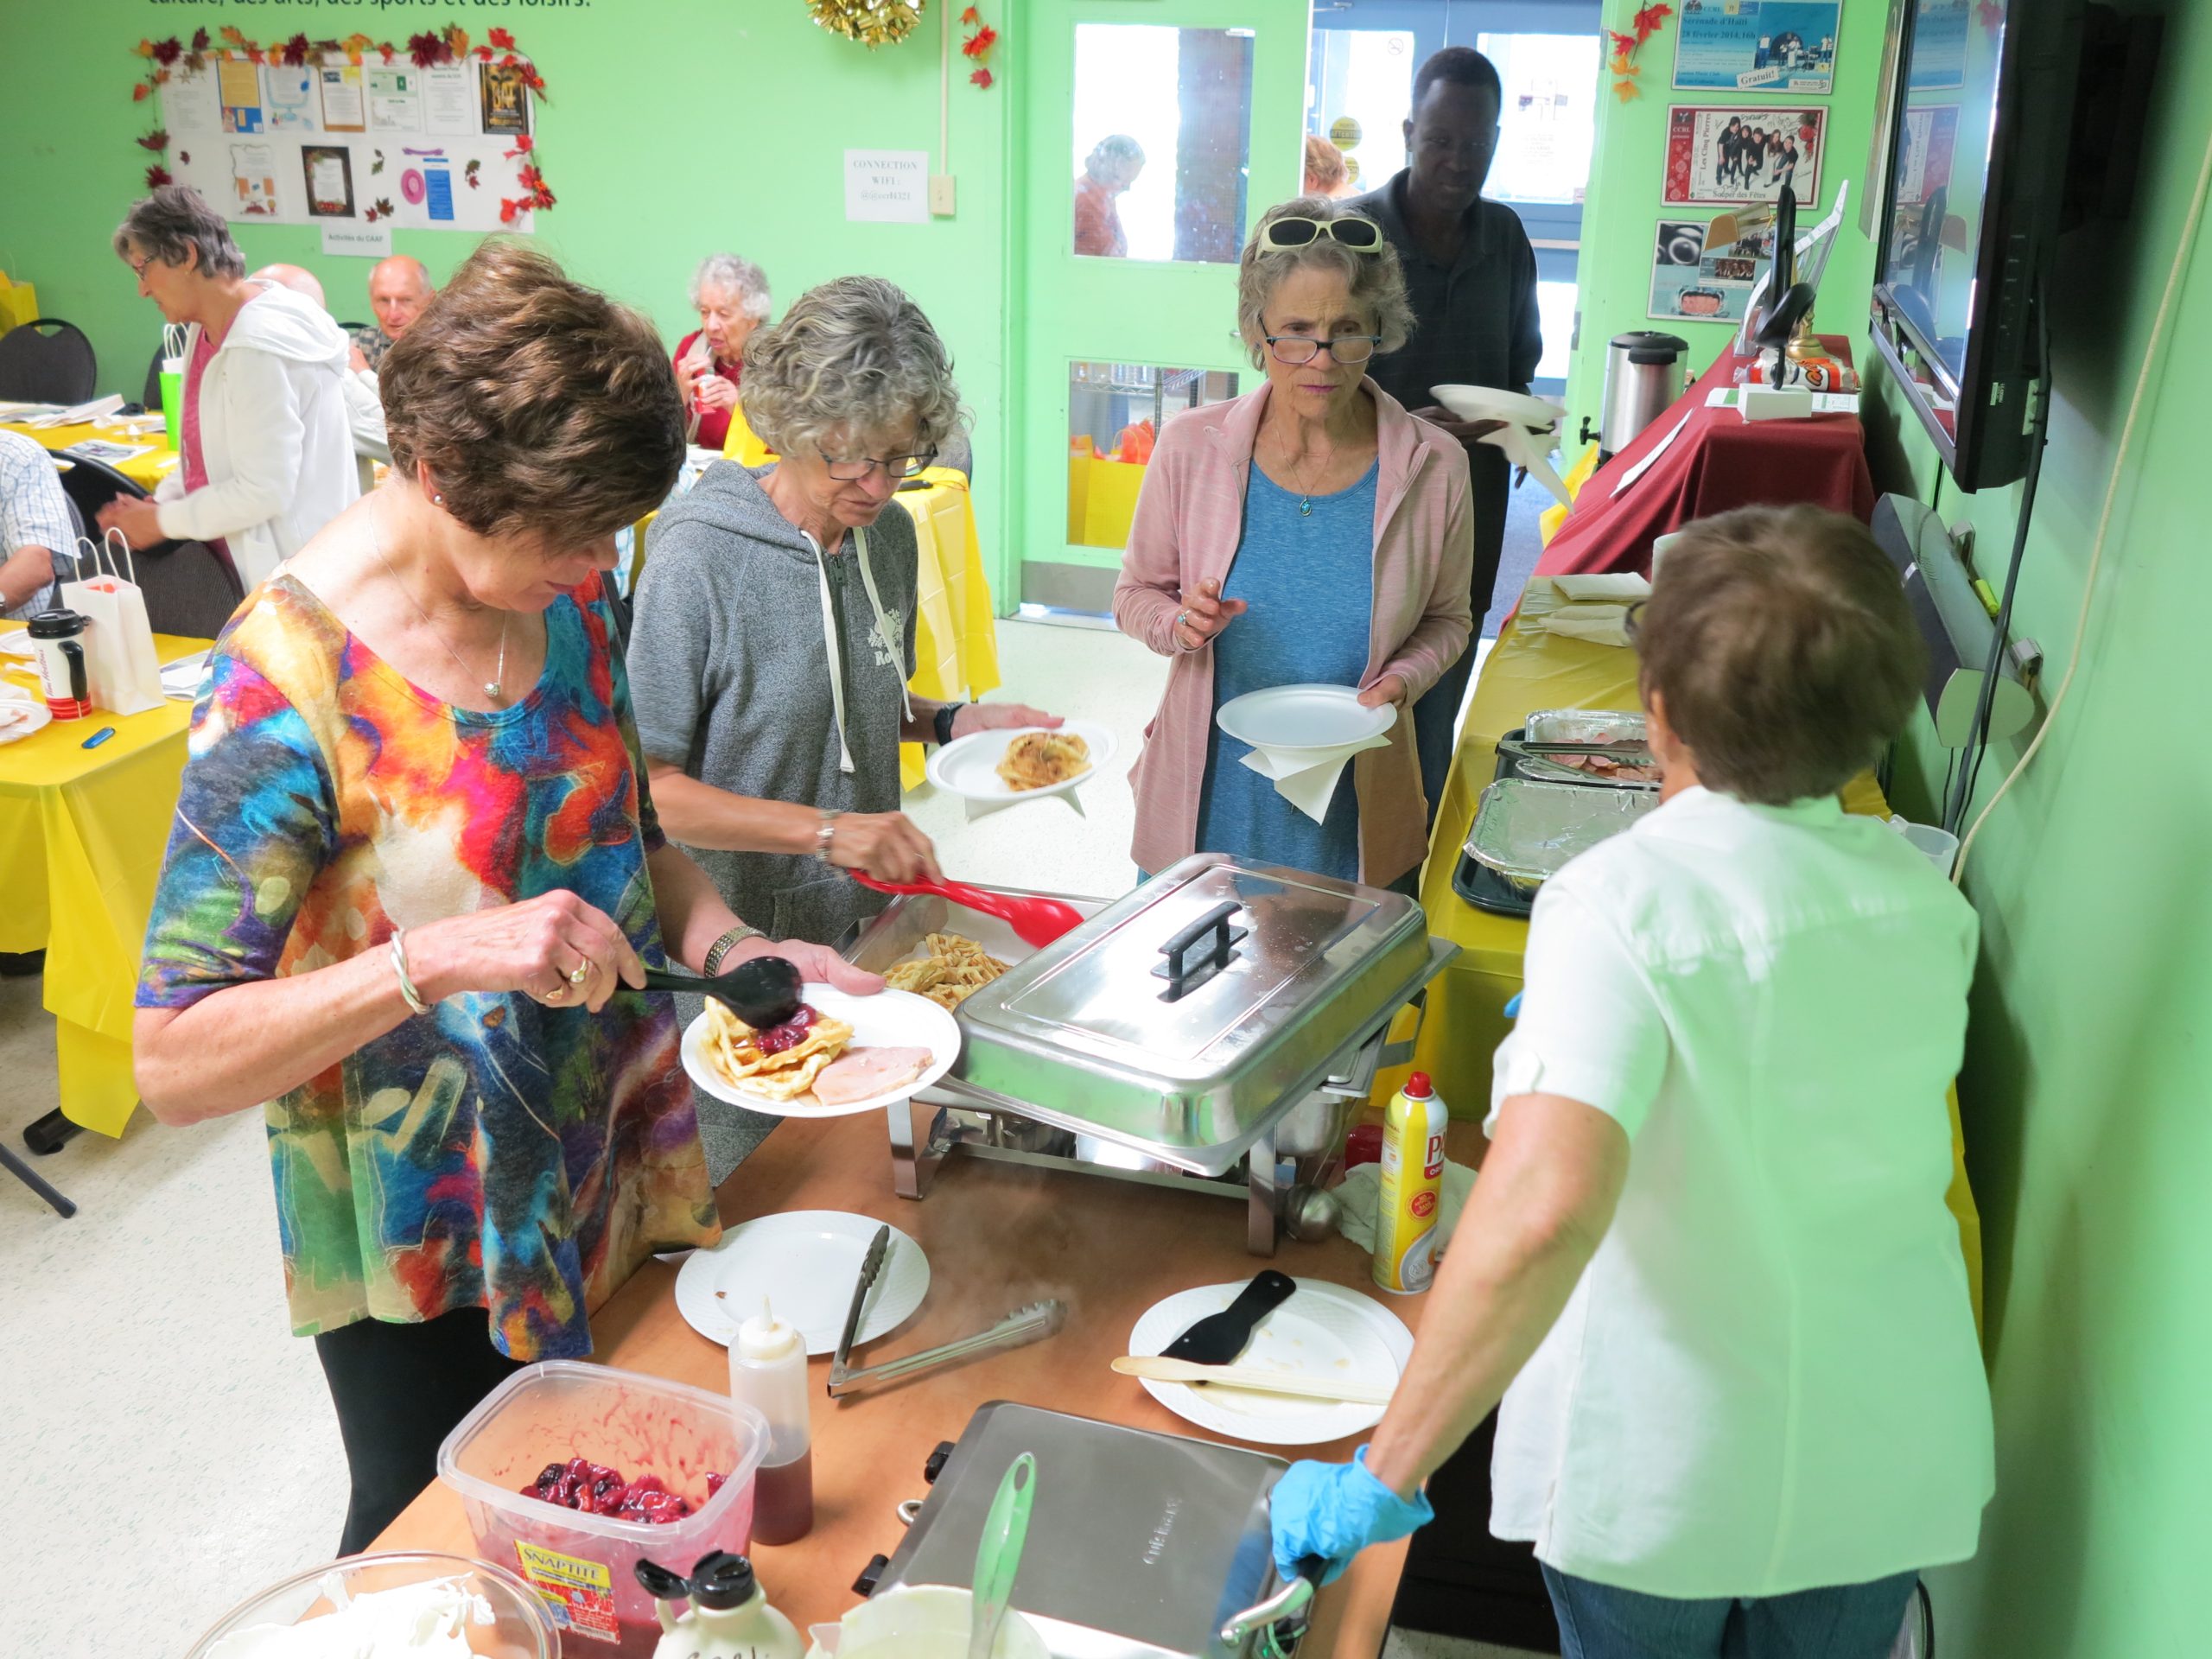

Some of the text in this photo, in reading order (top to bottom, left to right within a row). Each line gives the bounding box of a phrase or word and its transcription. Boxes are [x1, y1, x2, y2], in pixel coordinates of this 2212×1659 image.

[1740, 70, 1775, 85] Gratuit!
[1702, 113, 1712, 137] Pierres
[1700, 139, 1710, 156] Cinq
[853, 159, 918, 170] CONNECTION
[524, 1548, 600, 1580] SNAPTITE
